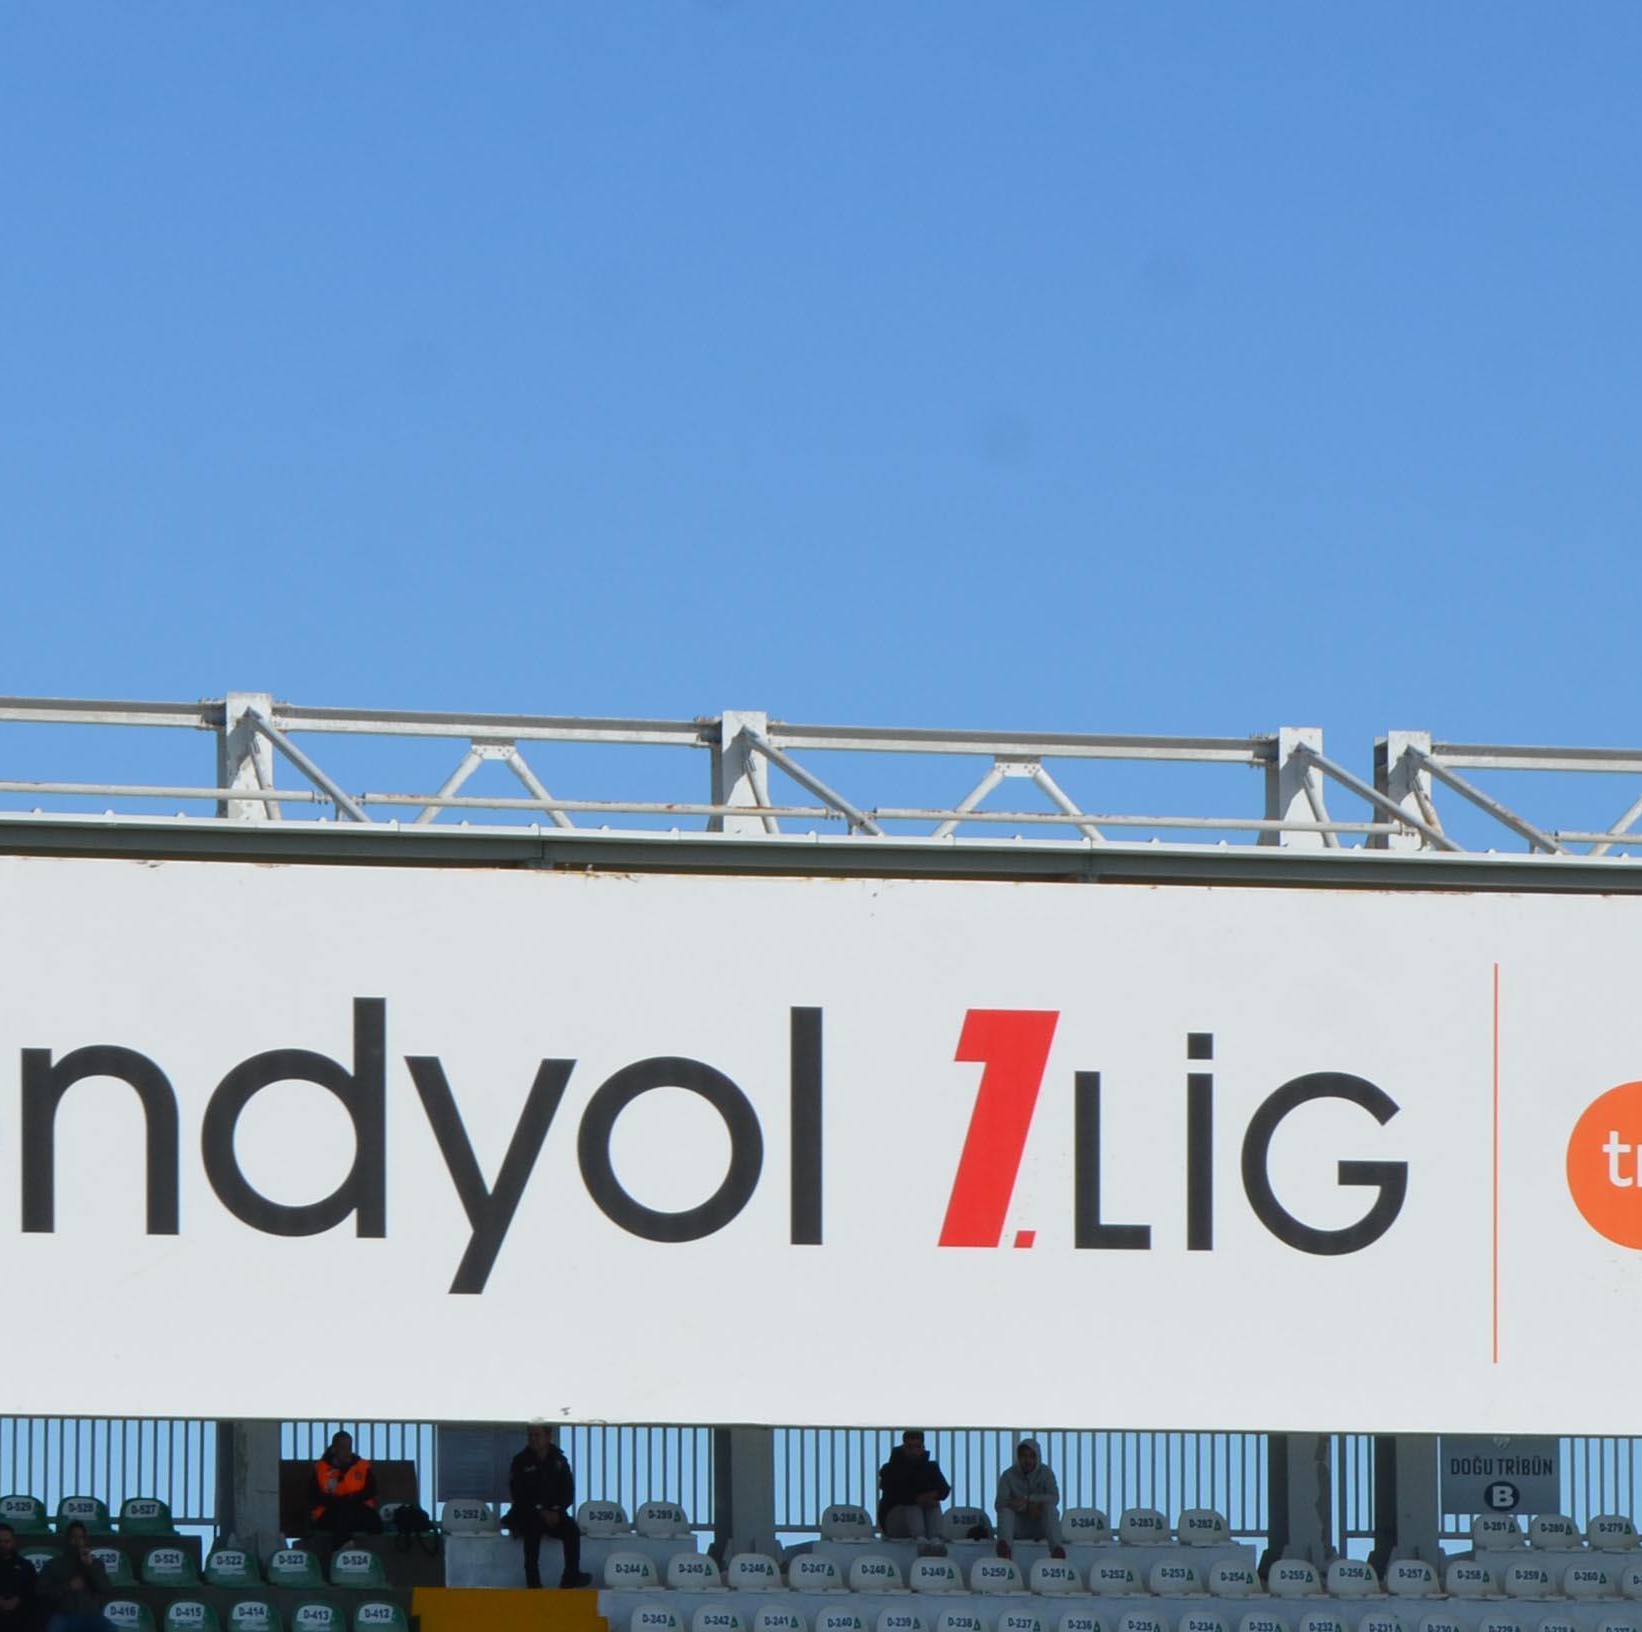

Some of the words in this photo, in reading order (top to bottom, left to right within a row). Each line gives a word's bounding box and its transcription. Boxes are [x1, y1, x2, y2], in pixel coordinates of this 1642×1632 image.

[1450, 1455, 1493, 1476] DOĞU
[1497, 1456, 1553, 1476] TRİBÜN
[1492, 1485, 1515, 1507] B
[739, 1563, 766, 1574] D-246
[1040, 1568, 1067, 1579] D-251
[1280, 1570, 1306, 1582] D-255
[1006, 1617, 1033, 1629] D-237
[1248, 1621, 1274, 1632] D-233
